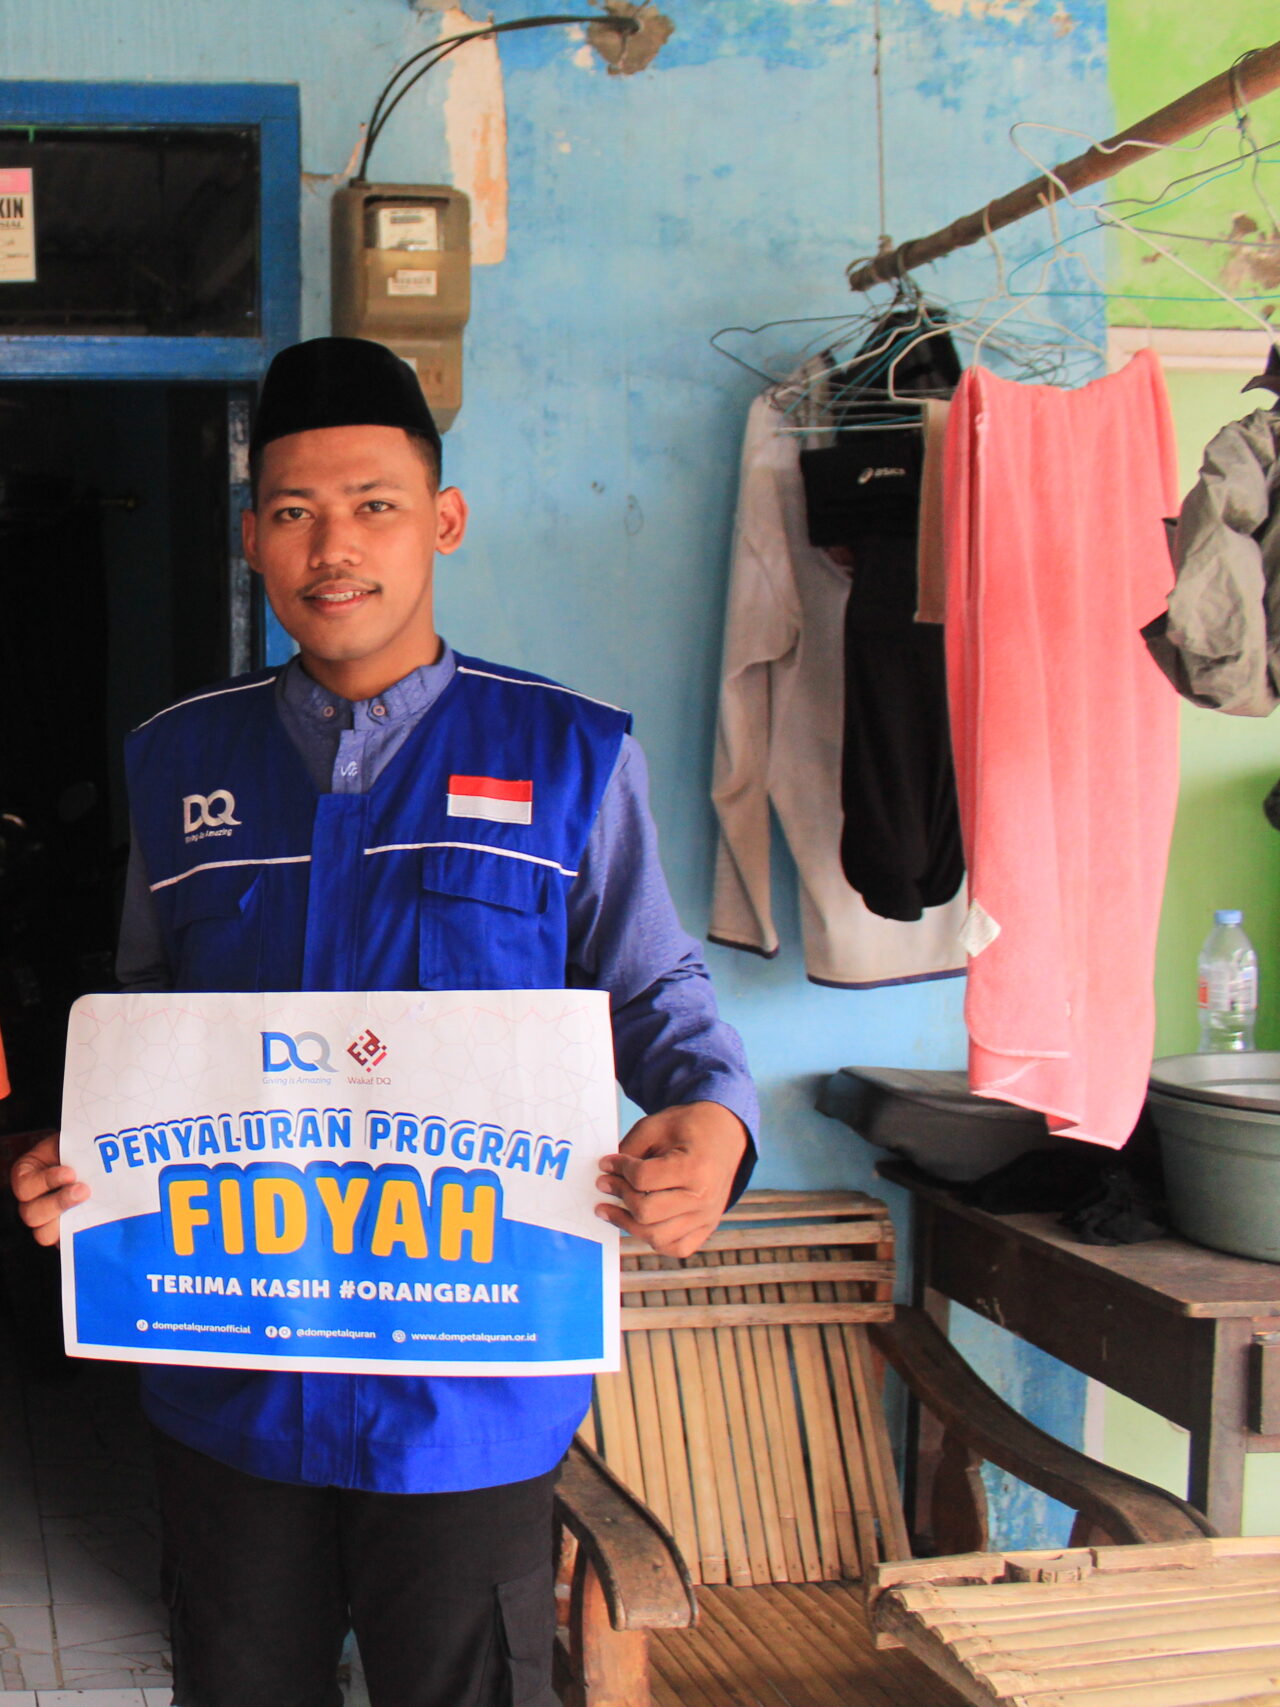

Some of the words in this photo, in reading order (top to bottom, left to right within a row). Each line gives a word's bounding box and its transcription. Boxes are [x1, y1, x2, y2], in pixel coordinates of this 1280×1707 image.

[182, 789, 242, 834] DQ
[260, 1031, 339, 1073] DQ
[296, 1077, 332, 1086] Amazing
[347, 1076, 375, 1085] Wakaf
[376, 1076, 392, 1086] DQ
[95, 1108, 352, 1174] PENYALURAN
[366, 1109, 573, 1181] PROGRAM
[167, 1176, 497, 1264] FIDYAH
[147, 1273, 243, 1297] TERIMA
[250, 1279, 330, 1299] KASIH
[339, 1281, 520, 1304] #ORANGBAIK
[152, 1320, 252, 1335] dompetalquranofficial
[296, 1327, 376, 1340] @dompetalquran
[411, 1331, 537, 1343] www.dompetalquran.or.id
